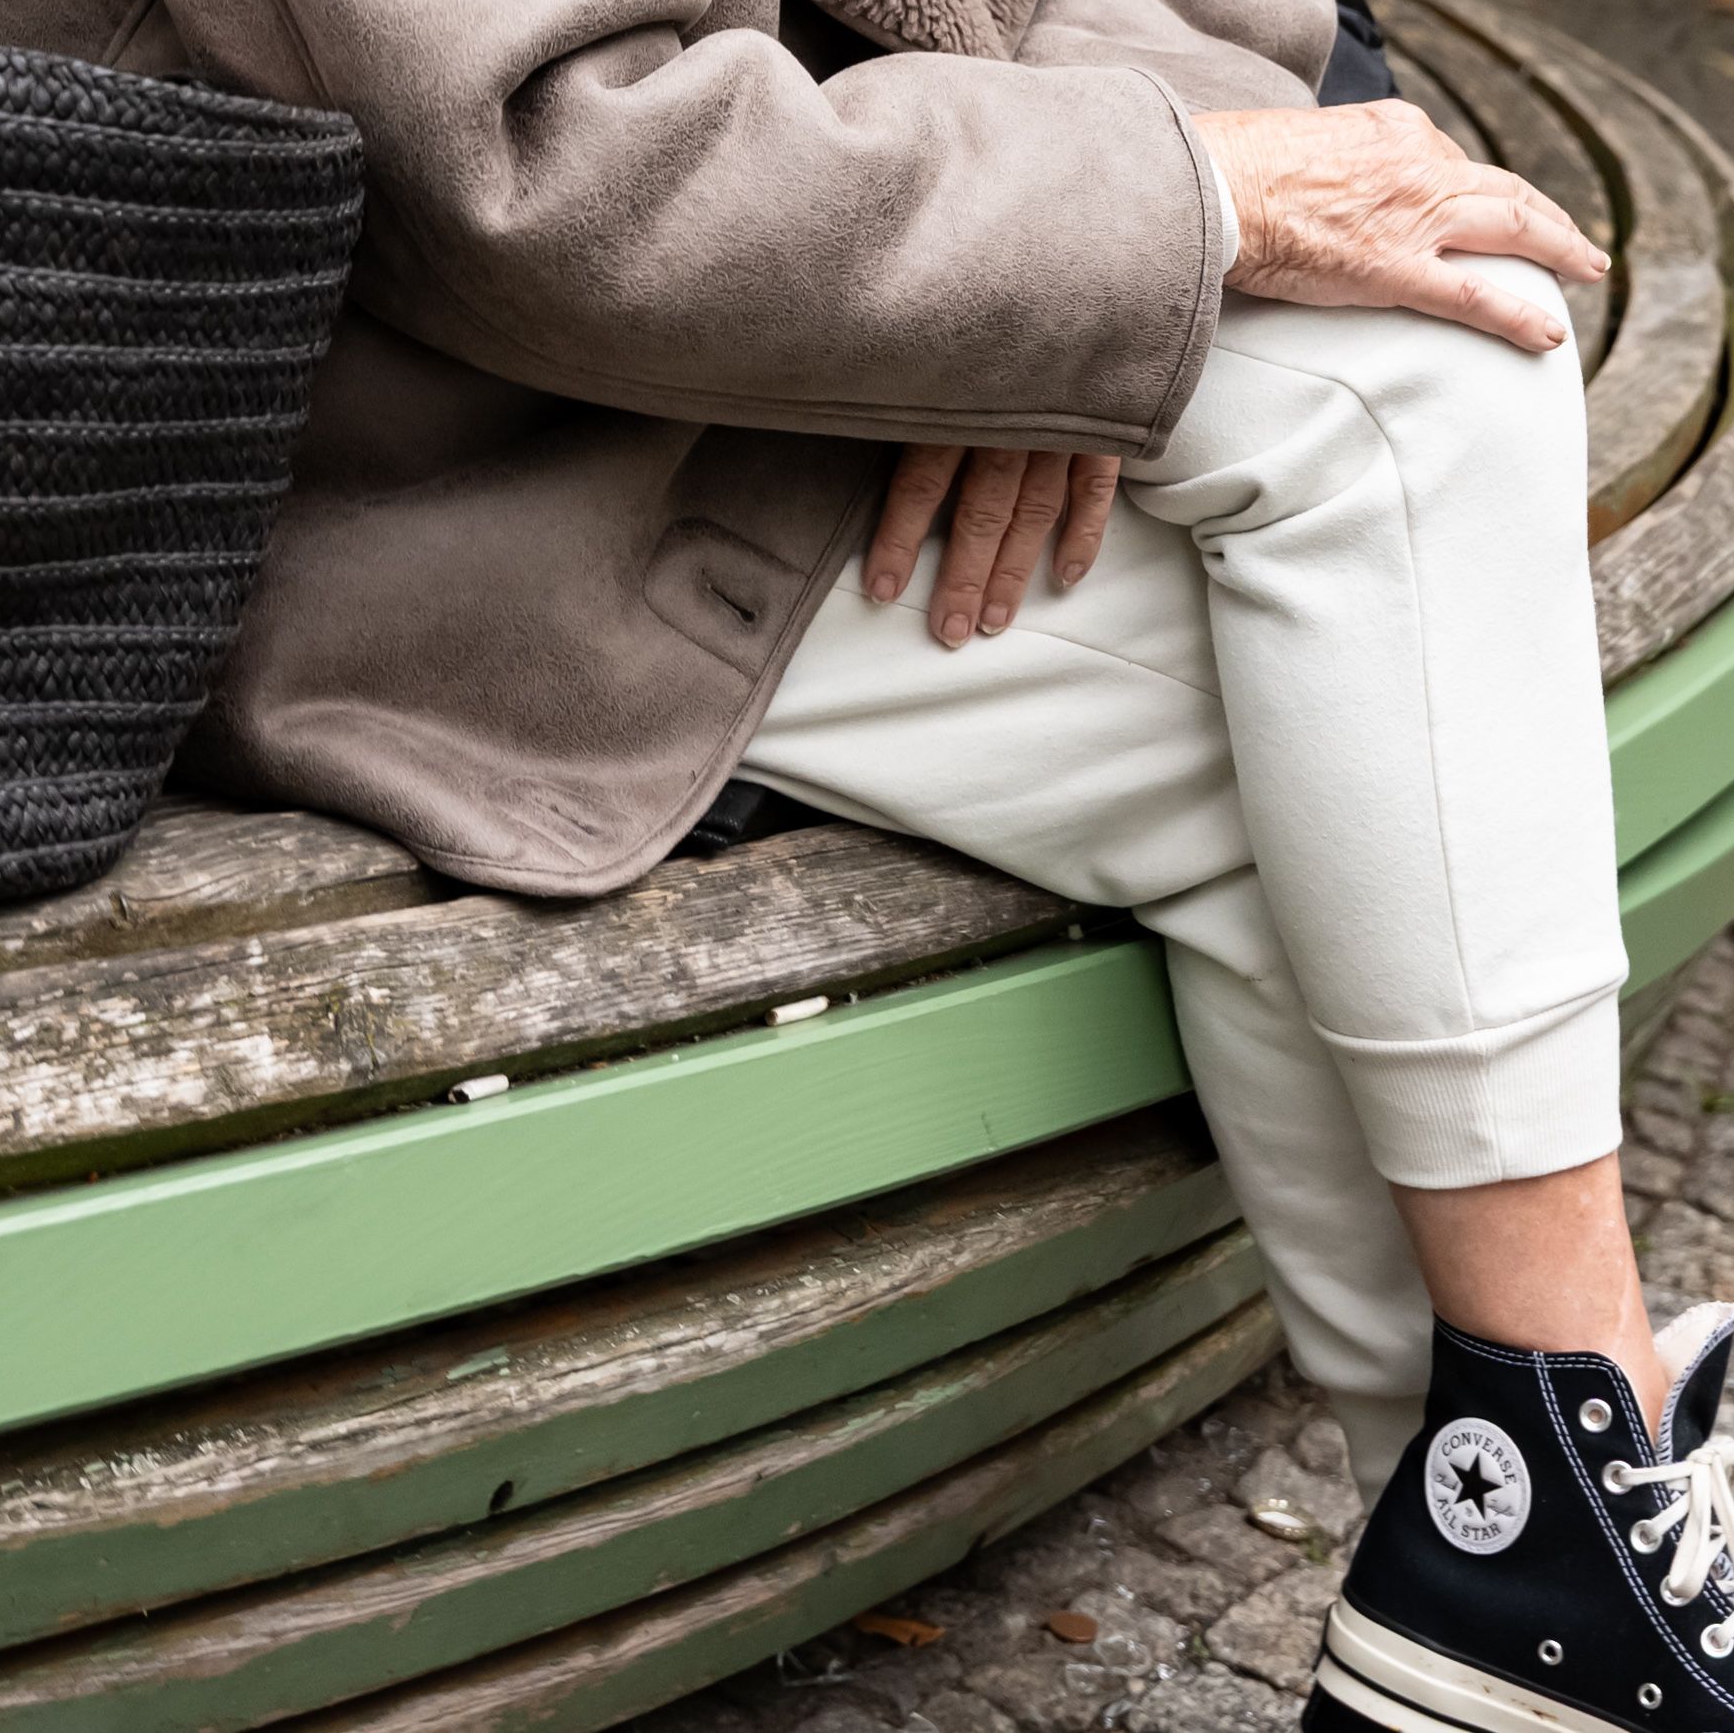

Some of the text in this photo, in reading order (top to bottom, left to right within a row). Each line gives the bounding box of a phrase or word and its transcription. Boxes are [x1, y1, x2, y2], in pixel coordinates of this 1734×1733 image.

[1441, 1431, 1517, 1485] CONVERSE
[1437, 1497, 1457, 1530] ALL
[1460, 1522, 1502, 1541] STAR
